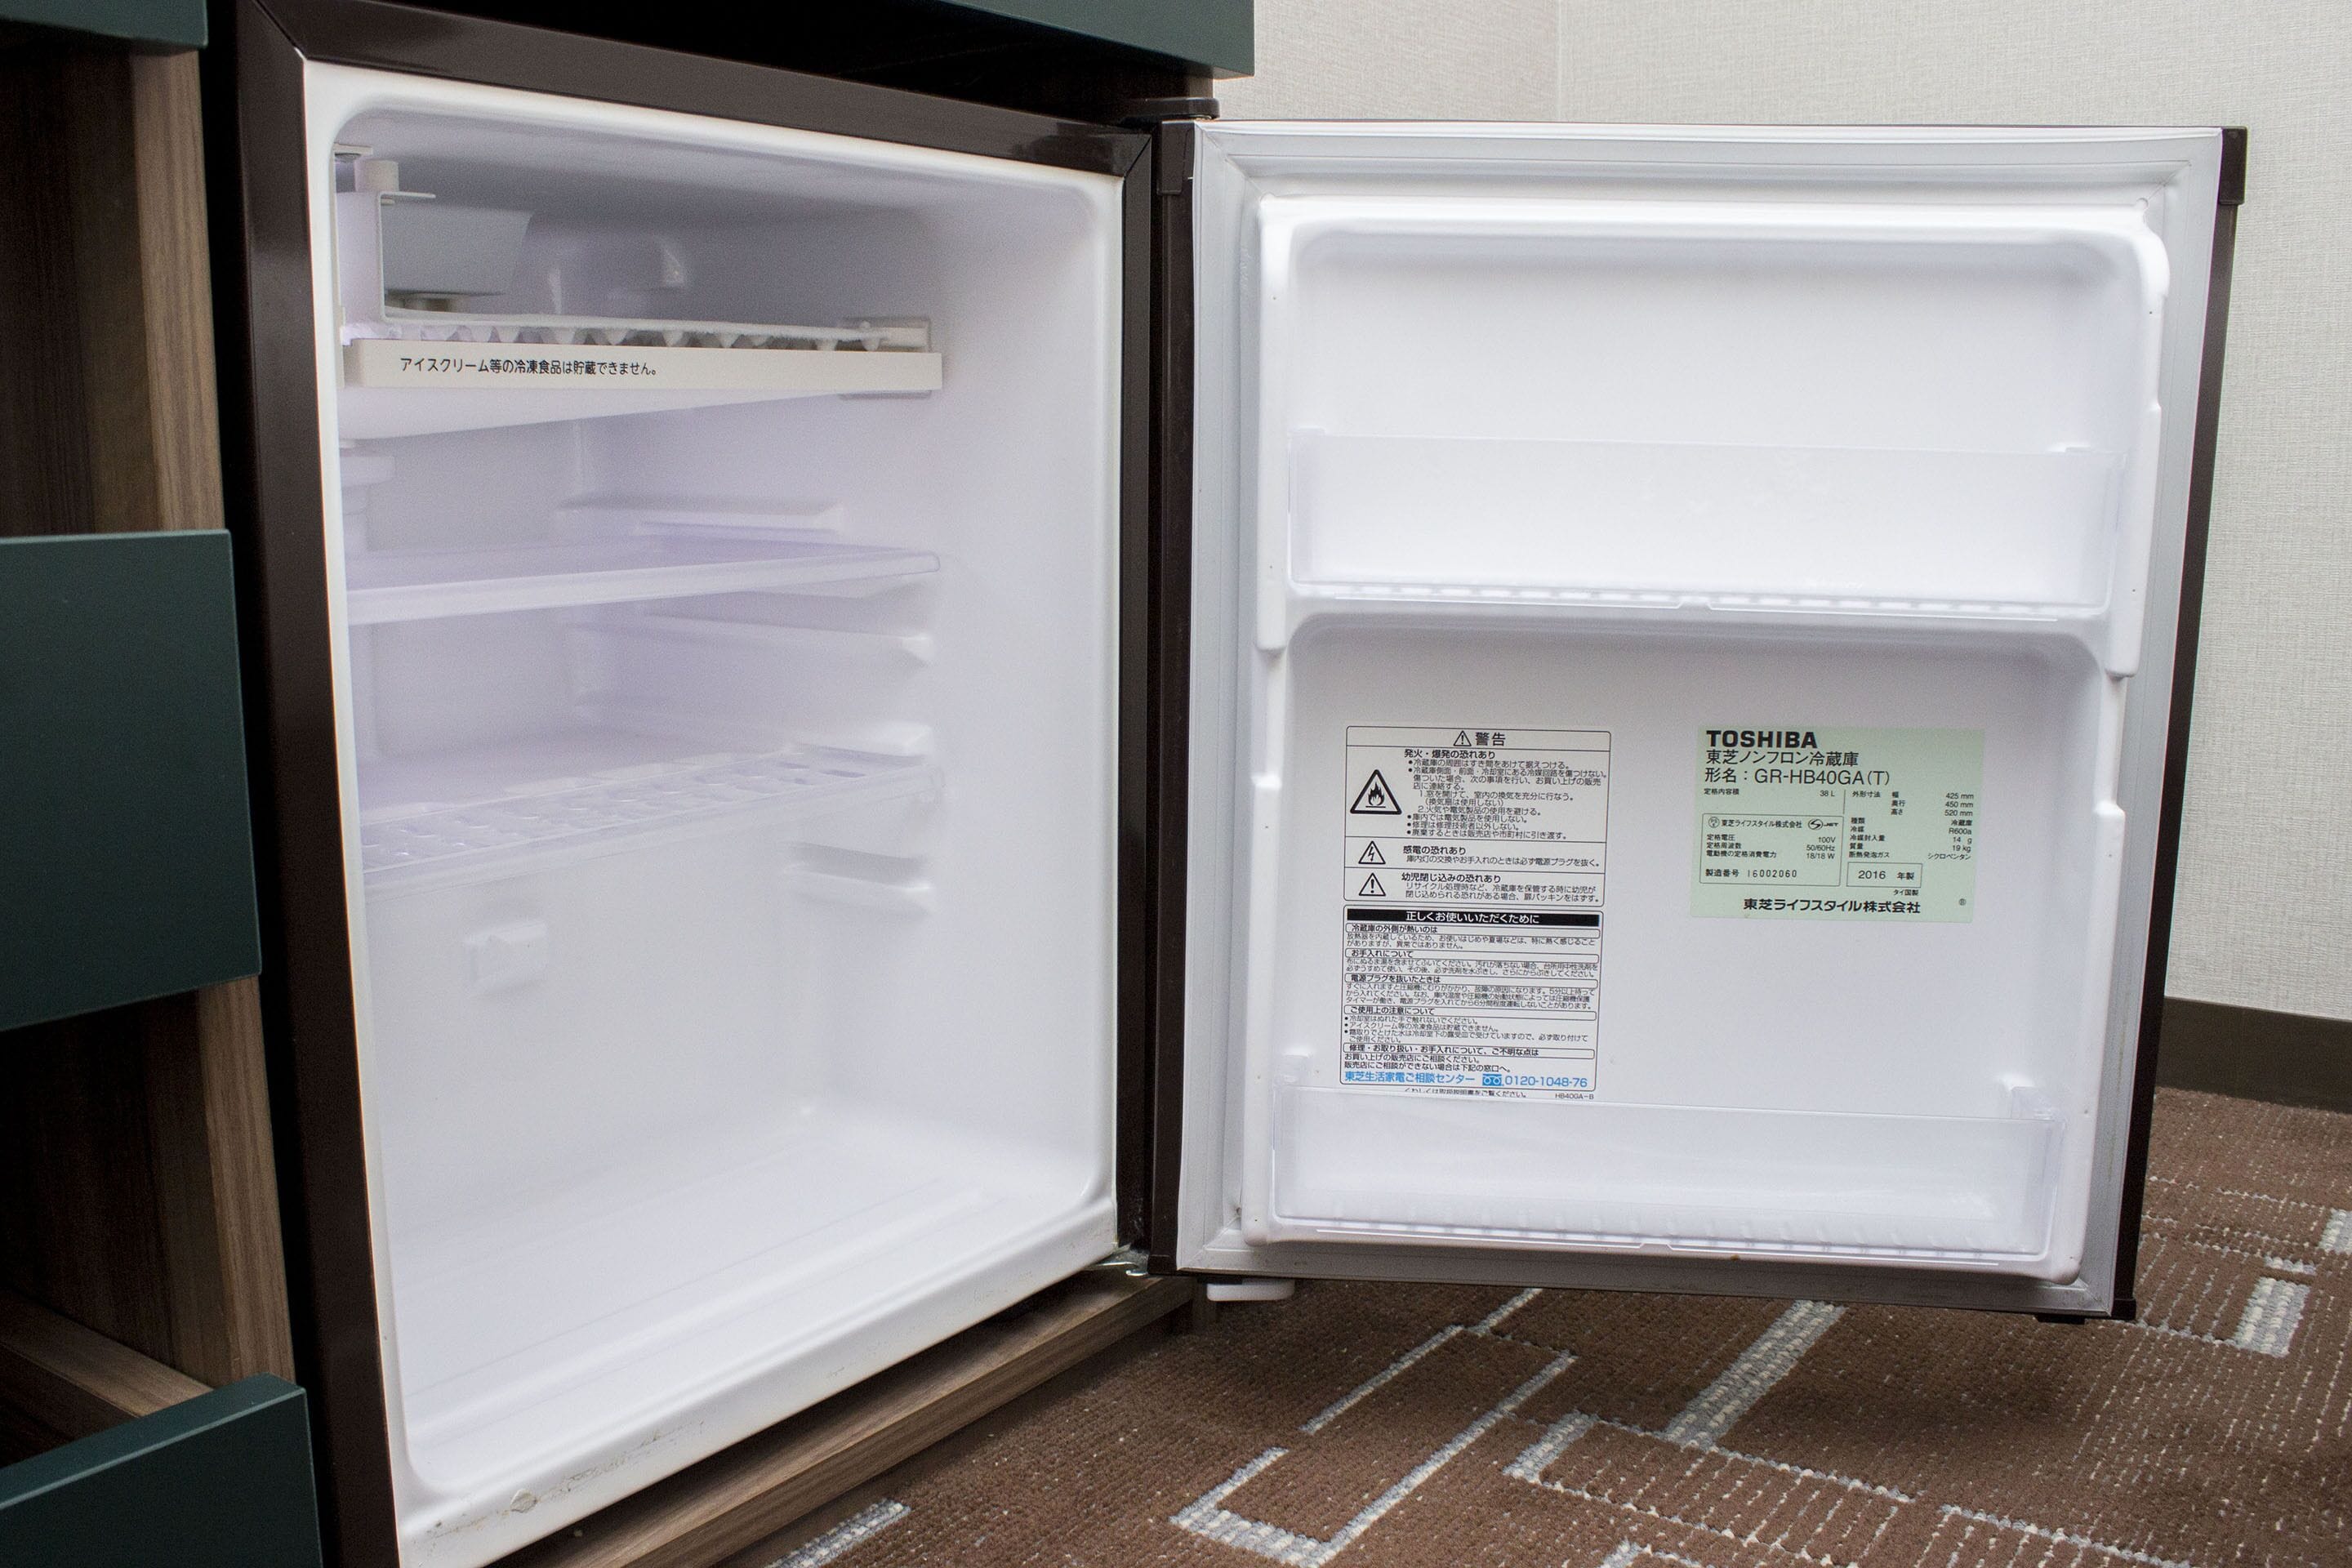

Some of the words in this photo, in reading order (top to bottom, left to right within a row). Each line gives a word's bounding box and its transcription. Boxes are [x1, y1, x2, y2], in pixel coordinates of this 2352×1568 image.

[400, 356, 658, 376] アイスクリーム等の冷凍食品は貯蔵できません。
[1475, 732, 1506, 746] 警告
[1706, 730, 1818, 749] TOSHIBA
[1405, 749, 1495, 760] 発火・爆発の恐れあり
[1706, 751, 1859, 767] 東芝ノンフロン冷蔵庫
[1704, 787, 1740, 795] 定格内容積
[1891, 808, 1904, 816] 高さ
[1721, 819, 1802, 829] 東芝ライフスタイル株式会社
[1949, 827, 1972, 835] R600a
[1403, 845, 1467, 856] 感電の恐れあり
[1706, 850, 1777, 858] 電動機の定格消費電力
[1952, 844, 1961, 853] 19
[1962, 844, 1971, 854] kg
[1401, 872, 1501, 884] 幼児閉じ込みの恐れあり
[1705, 868, 1740, 878] 製造番号
[1858, 870, 1886, 880] 2016
[1896, 871, 1914, 880] 年製
[1893, 889, 1919, 897] タイ国製
[1744, 898, 1921, 915] 東芝ライフスタイル株式会社
[1405, 911, 1540, 924] 正しくお使いいただくために
[1352, 949, 1414, 958] お手入れについて
[1351, 974, 1441, 983] 電源プラグを抜いたときは
[1351, 1006, 1435, 1015] ご使用上の注意について
[1344, 1071, 1475, 1085] 東芝生活家電ご相談センター
[1504, 1075, 1588, 1088] 0120-1048-76
